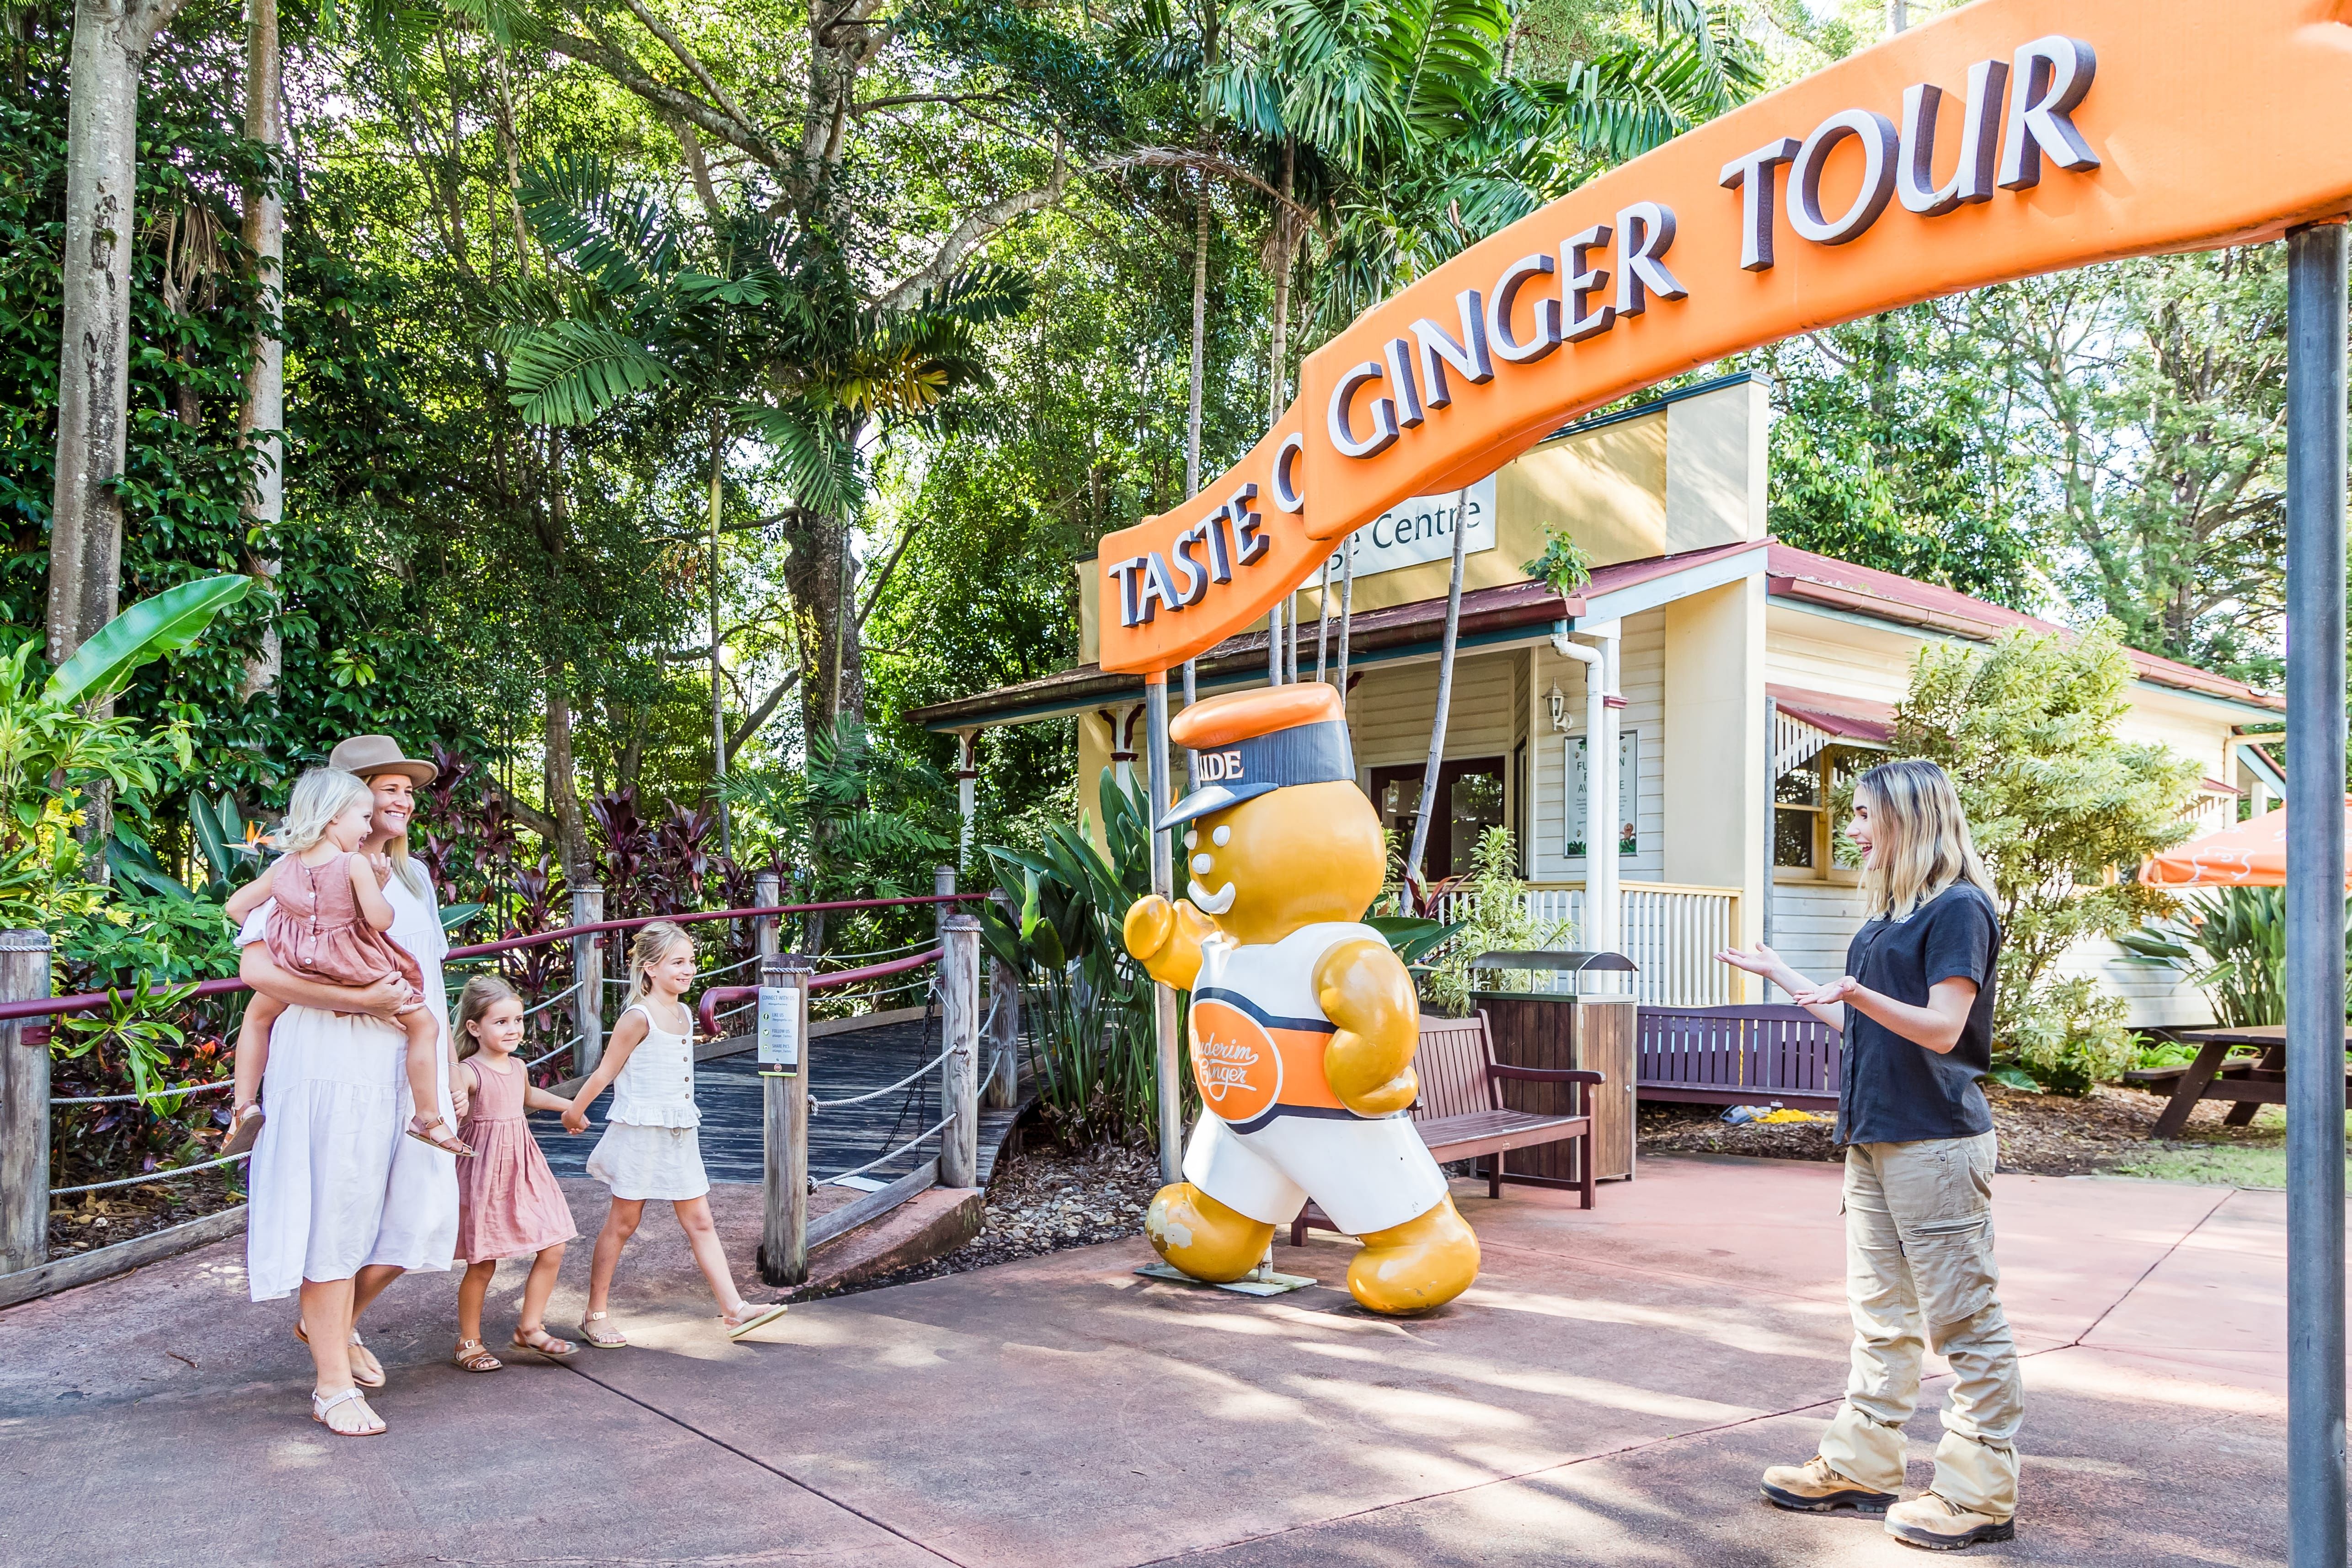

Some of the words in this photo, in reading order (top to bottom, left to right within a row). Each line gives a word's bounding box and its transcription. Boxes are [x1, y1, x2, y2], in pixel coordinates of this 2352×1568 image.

[1327, 201, 1688, 459] GINGER
[1719, 35, 2101, 273] TOUR
[1108, 482, 1270, 628] TASTE
[1372, 502, 1481, 549] Centre
[1198, 1058, 1257, 1101] Ginger
